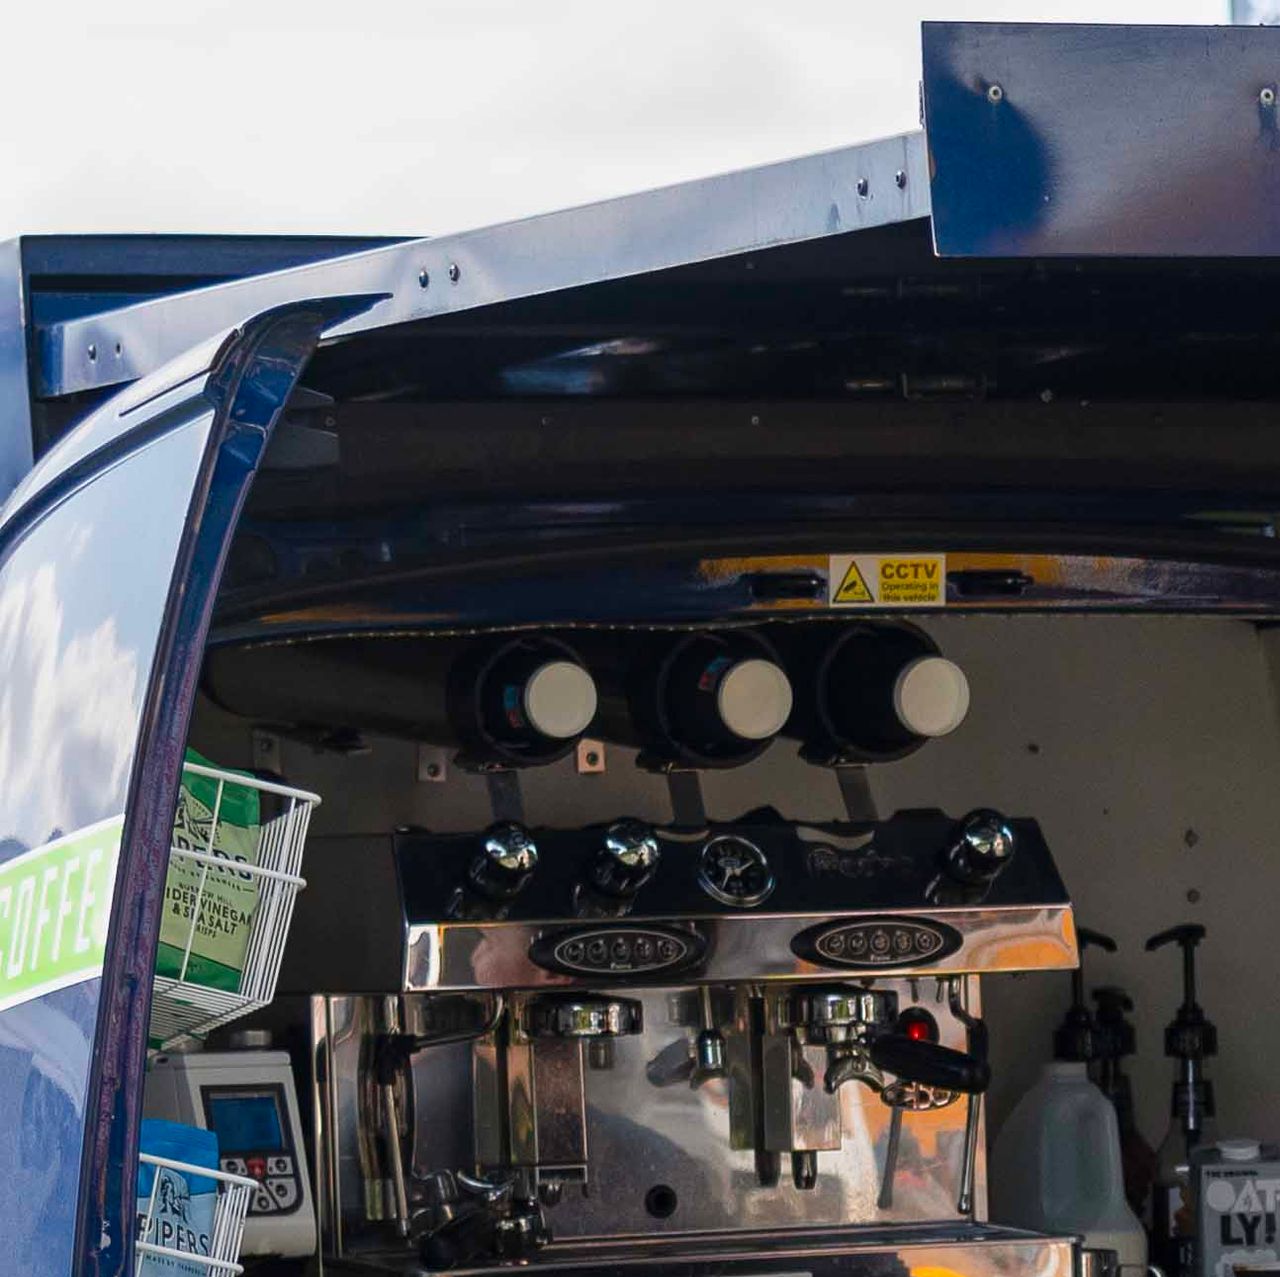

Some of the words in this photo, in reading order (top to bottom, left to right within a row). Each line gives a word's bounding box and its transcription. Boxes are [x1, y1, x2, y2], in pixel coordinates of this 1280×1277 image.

[881, 563, 937, 579] CCTV
[0, 843, 120, 979] OFFE
[166, 887, 196, 907] IDER
[209, 914, 238, 936] SALT
[138, 1214, 209, 1256] PIPERS
[1220, 1212, 1277, 1246] LY!
